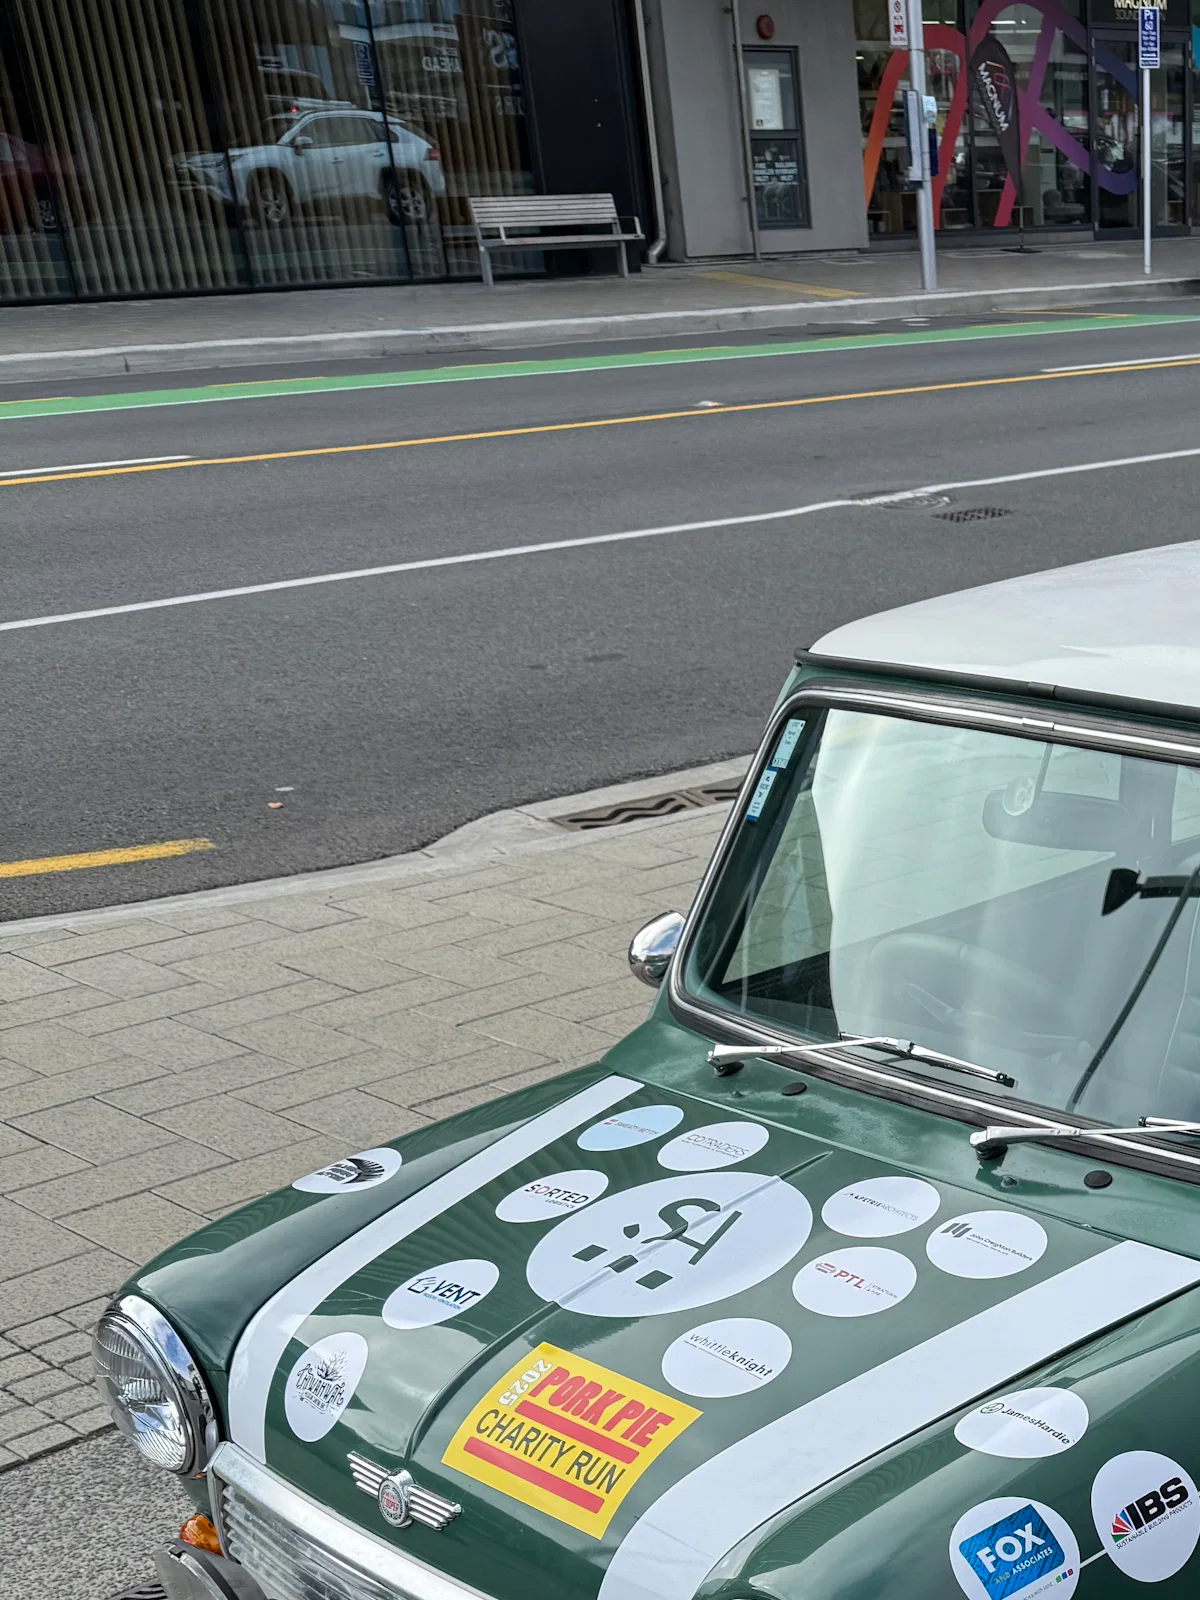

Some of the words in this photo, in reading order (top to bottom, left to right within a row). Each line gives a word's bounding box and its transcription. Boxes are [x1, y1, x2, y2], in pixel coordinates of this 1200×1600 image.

[978, 62, 1009, 131] MAGNUM
[525, 1184, 589, 1204] SORTED
[431, 1280, 481, 1304] VENT
[833, 1270, 865, 1289] PTL
[690, 1333, 773, 1377] whittleknight
[498, 1358, 552, 1406] 2025
[528, 1366, 626, 1424] PORK
[603, 1398, 675, 1448] PIE
[1001, 1408, 1070, 1445] JamesHardie
[476, 1408, 575, 1468] CHARITY
[565, 1450, 626, 1495] RUN
[1116, 1527, 1148, 1550] SUSTAINABLE
[1147, 1514, 1170, 1531] BUILDING
[1169, 1499, 1192, 1517] PRODUCTS
[1125, 1477, 1189, 1530] IBS
[976, 1522, 1046, 1574] FOX
[1012, 1547, 1053, 1575] ASSOCIATES
